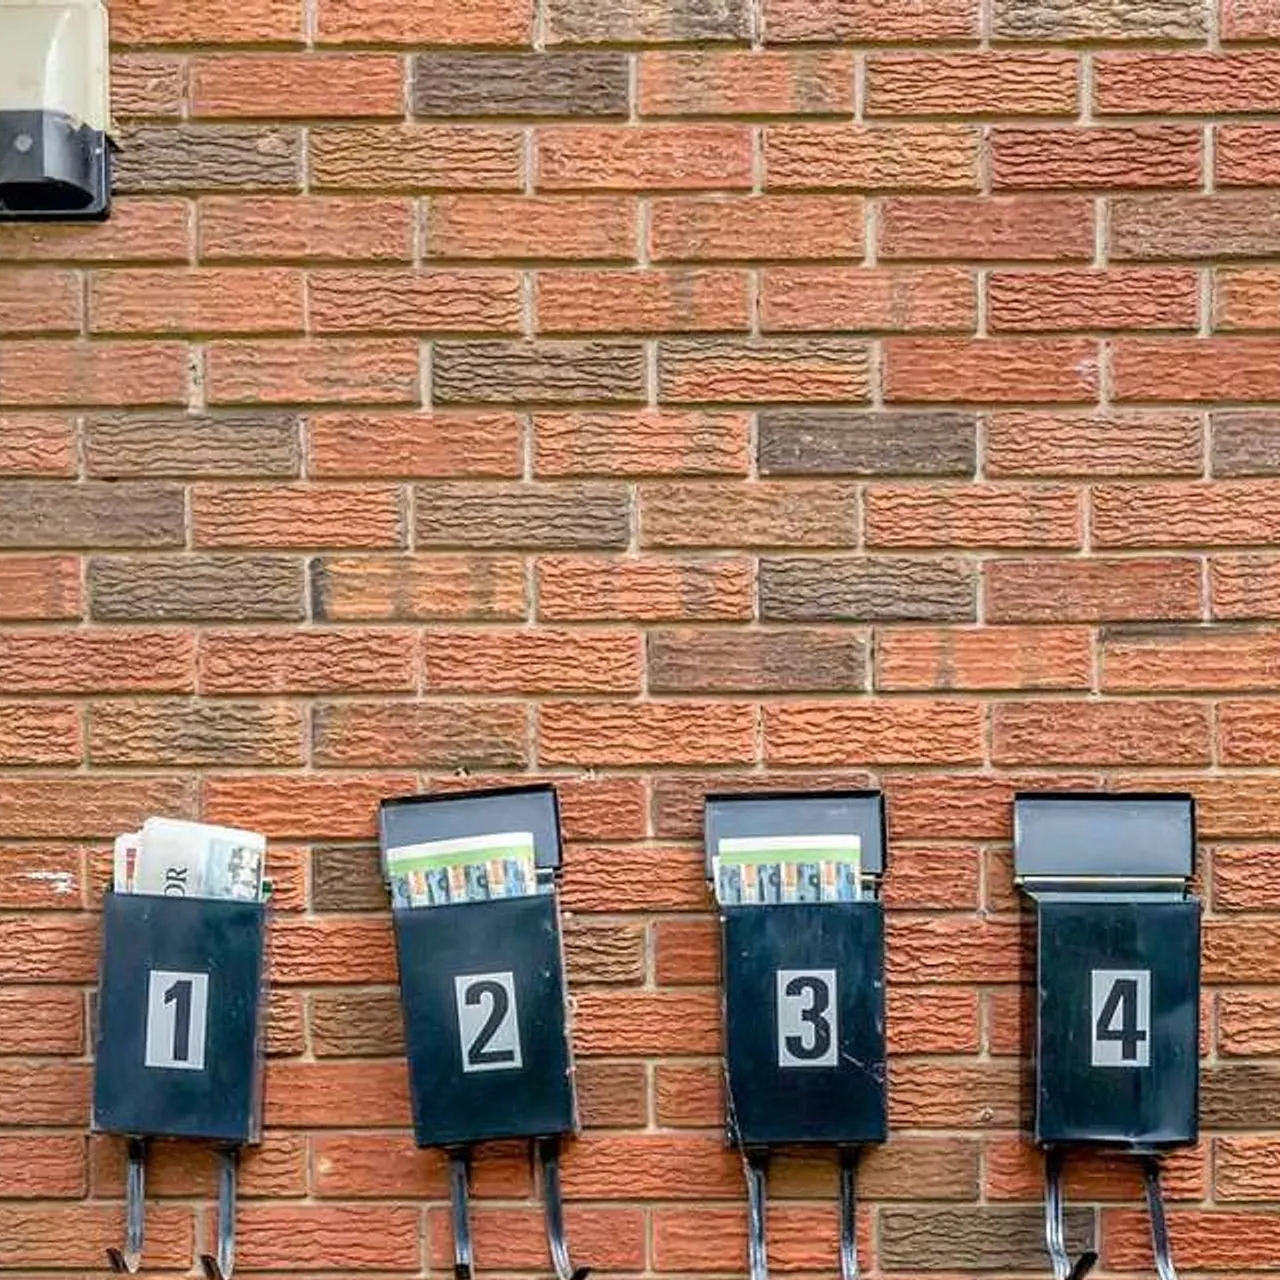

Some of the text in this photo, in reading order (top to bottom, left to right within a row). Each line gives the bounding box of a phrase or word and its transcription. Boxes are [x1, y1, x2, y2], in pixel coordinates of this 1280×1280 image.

[163, 979, 193, 1062] 1
[464, 979, 515, 1065] 2
[785, 976, 832, 1060] 3
[1096, 978, 1147, 1060] 4
